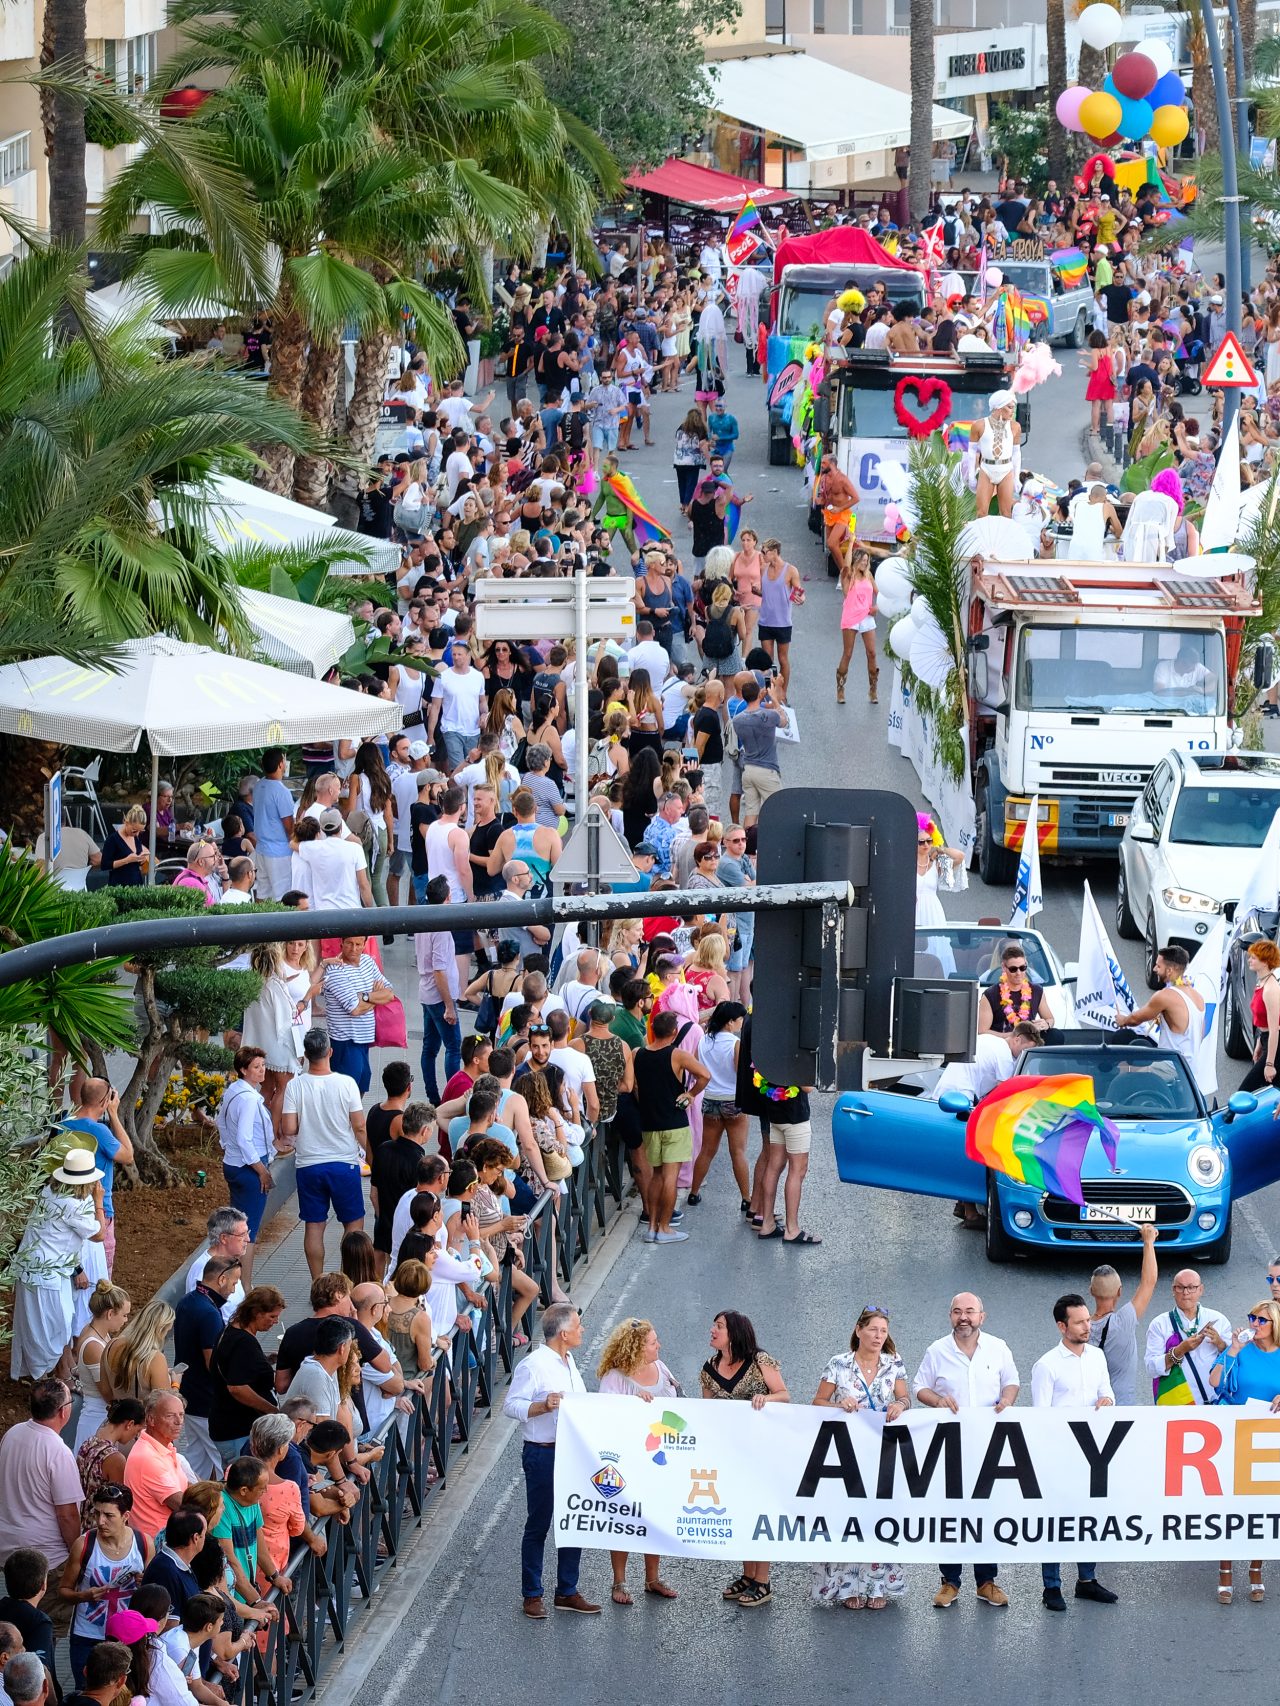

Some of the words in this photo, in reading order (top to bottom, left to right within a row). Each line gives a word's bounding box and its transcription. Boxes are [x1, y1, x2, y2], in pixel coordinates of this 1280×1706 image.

[732, 237, 752, 261] PSOE
[993, 239, 1006, 260] LA
[1011, 238, 1044, 261] TROYA
[1098, 772, 1142, 783] IVECO
[1127, 1206, 1152, 1219] JYK
[663, 1432, 697, 1446] Ibiza
[796, 1415, 1043, 1499] AMA
[1067, 1421, 1134, 1498] Y
[567, 1493, 643, 1519] Consell
[559, 1513, 648, 1538] d'Eivissa
[752, 1515, 832, 1542] AMA
[841, 1517, 865, 1542] A
[874, 1516, 983, 1547] QUIEN
[993, 1515, 1153, 1548] QUIERAS,
[681, 1538, 727, 1546] www.eivissa.es
